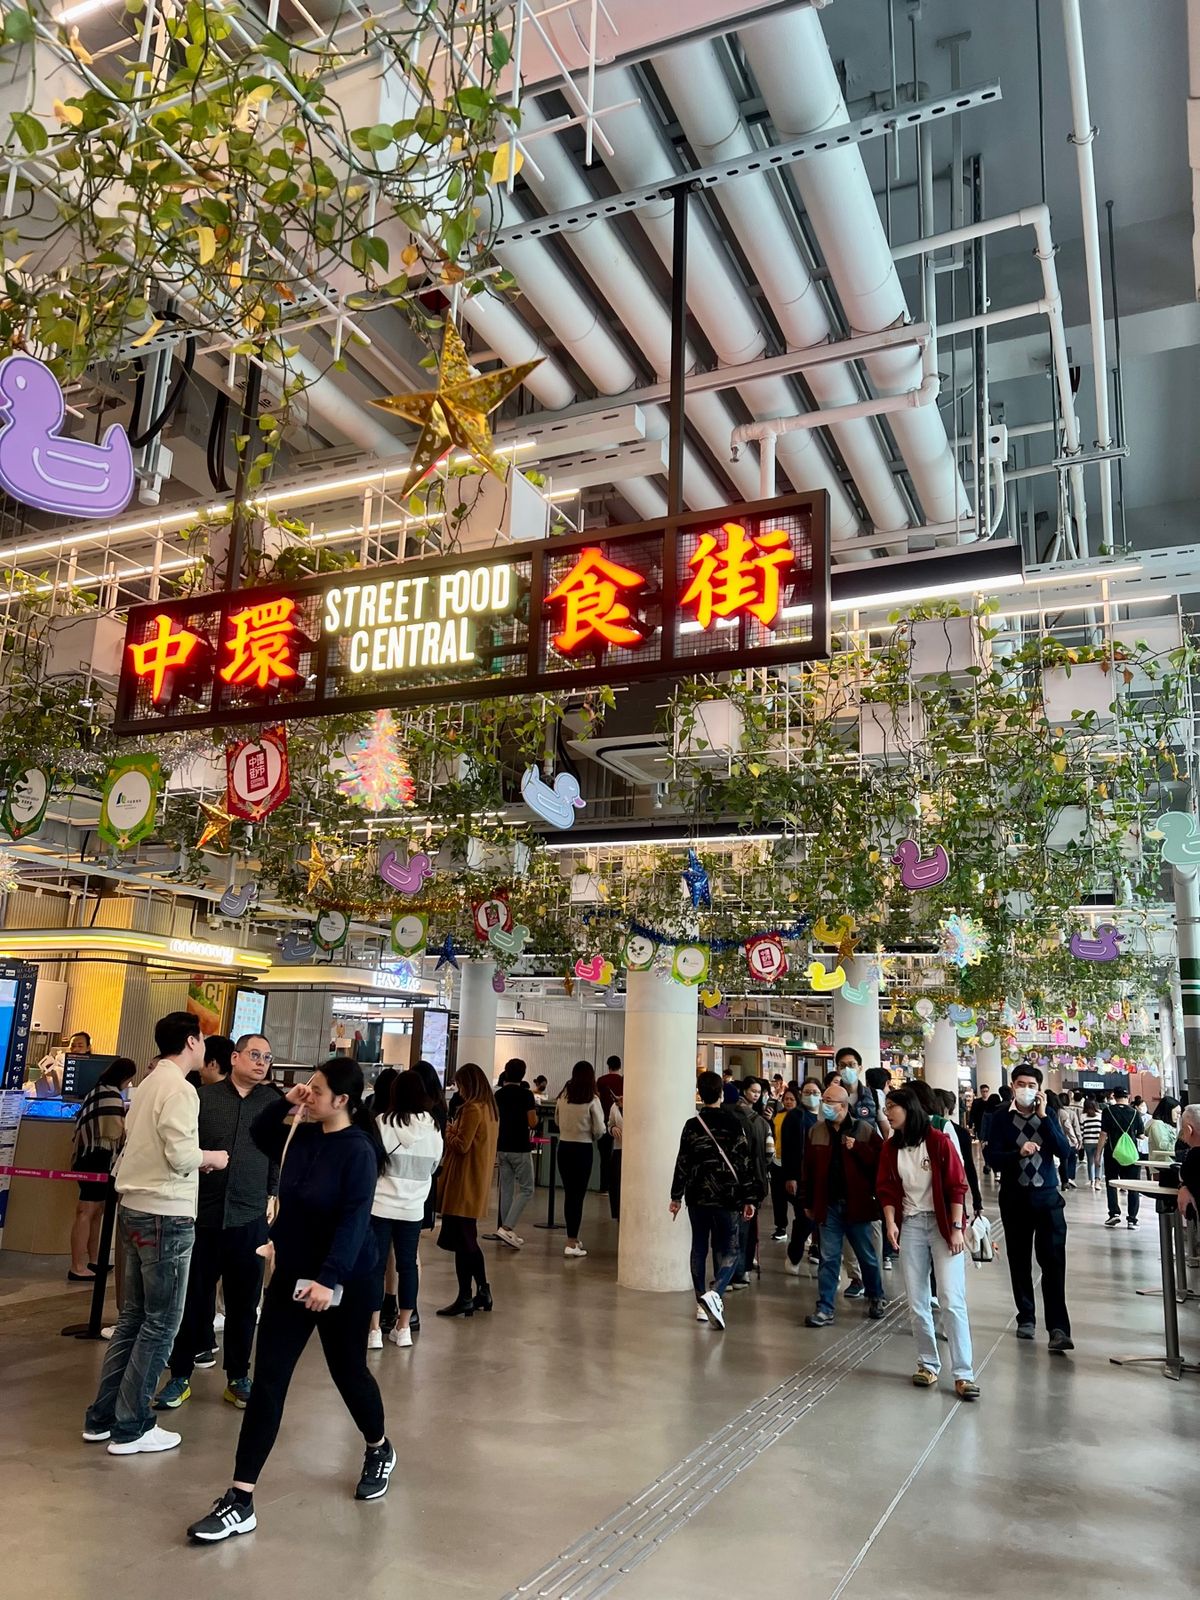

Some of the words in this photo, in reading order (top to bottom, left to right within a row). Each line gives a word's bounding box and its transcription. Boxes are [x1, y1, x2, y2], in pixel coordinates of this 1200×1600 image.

[325, 577, 429, 633] STREET
[438, 564, 511, 619] FOOD
[543, 522, 795, 652] 食街
[127, 596, 296, 704] 中環
[349, 616, 475, 674] CENTRAL
